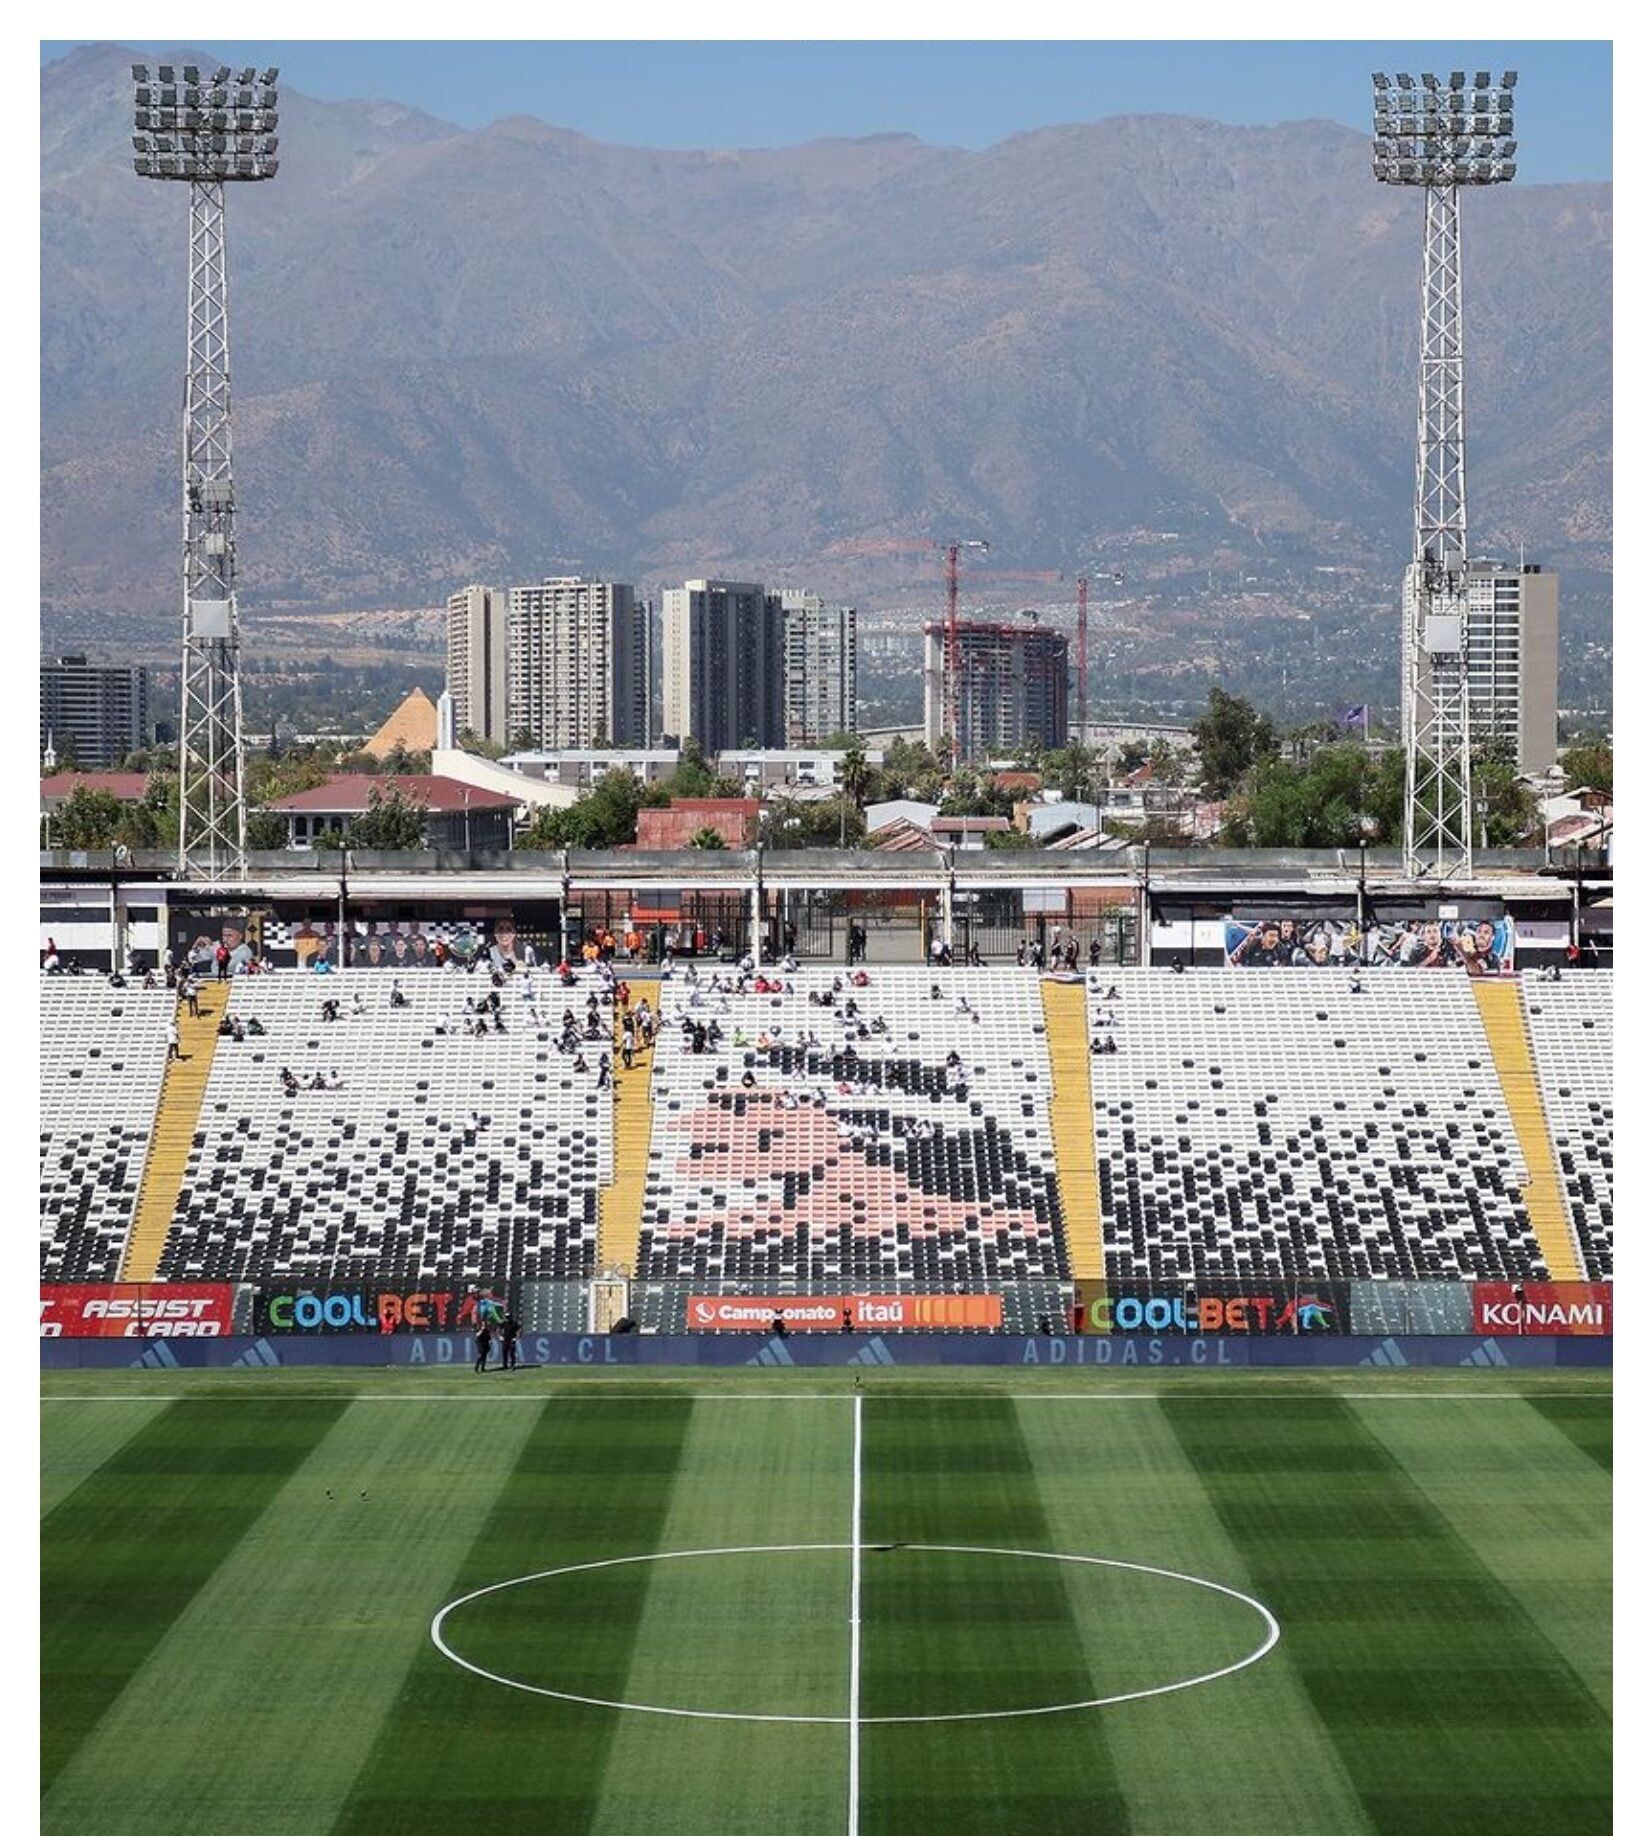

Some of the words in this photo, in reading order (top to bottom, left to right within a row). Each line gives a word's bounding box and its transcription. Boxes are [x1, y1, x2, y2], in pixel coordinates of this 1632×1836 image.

[82, 1300, 213, 1319] ASSIST
[719, 1303, 836, 1326] Camponato
[858, 1301, 903, 1321] itaú
[1091, 1297, 1274, 1330] COOLBET
[1482, 1303, 1602, 1325] KONAMI
[125, 1320, 221, 1337] CARD
[1023, 1339, 1231, 1364] ADIDAS.CL
